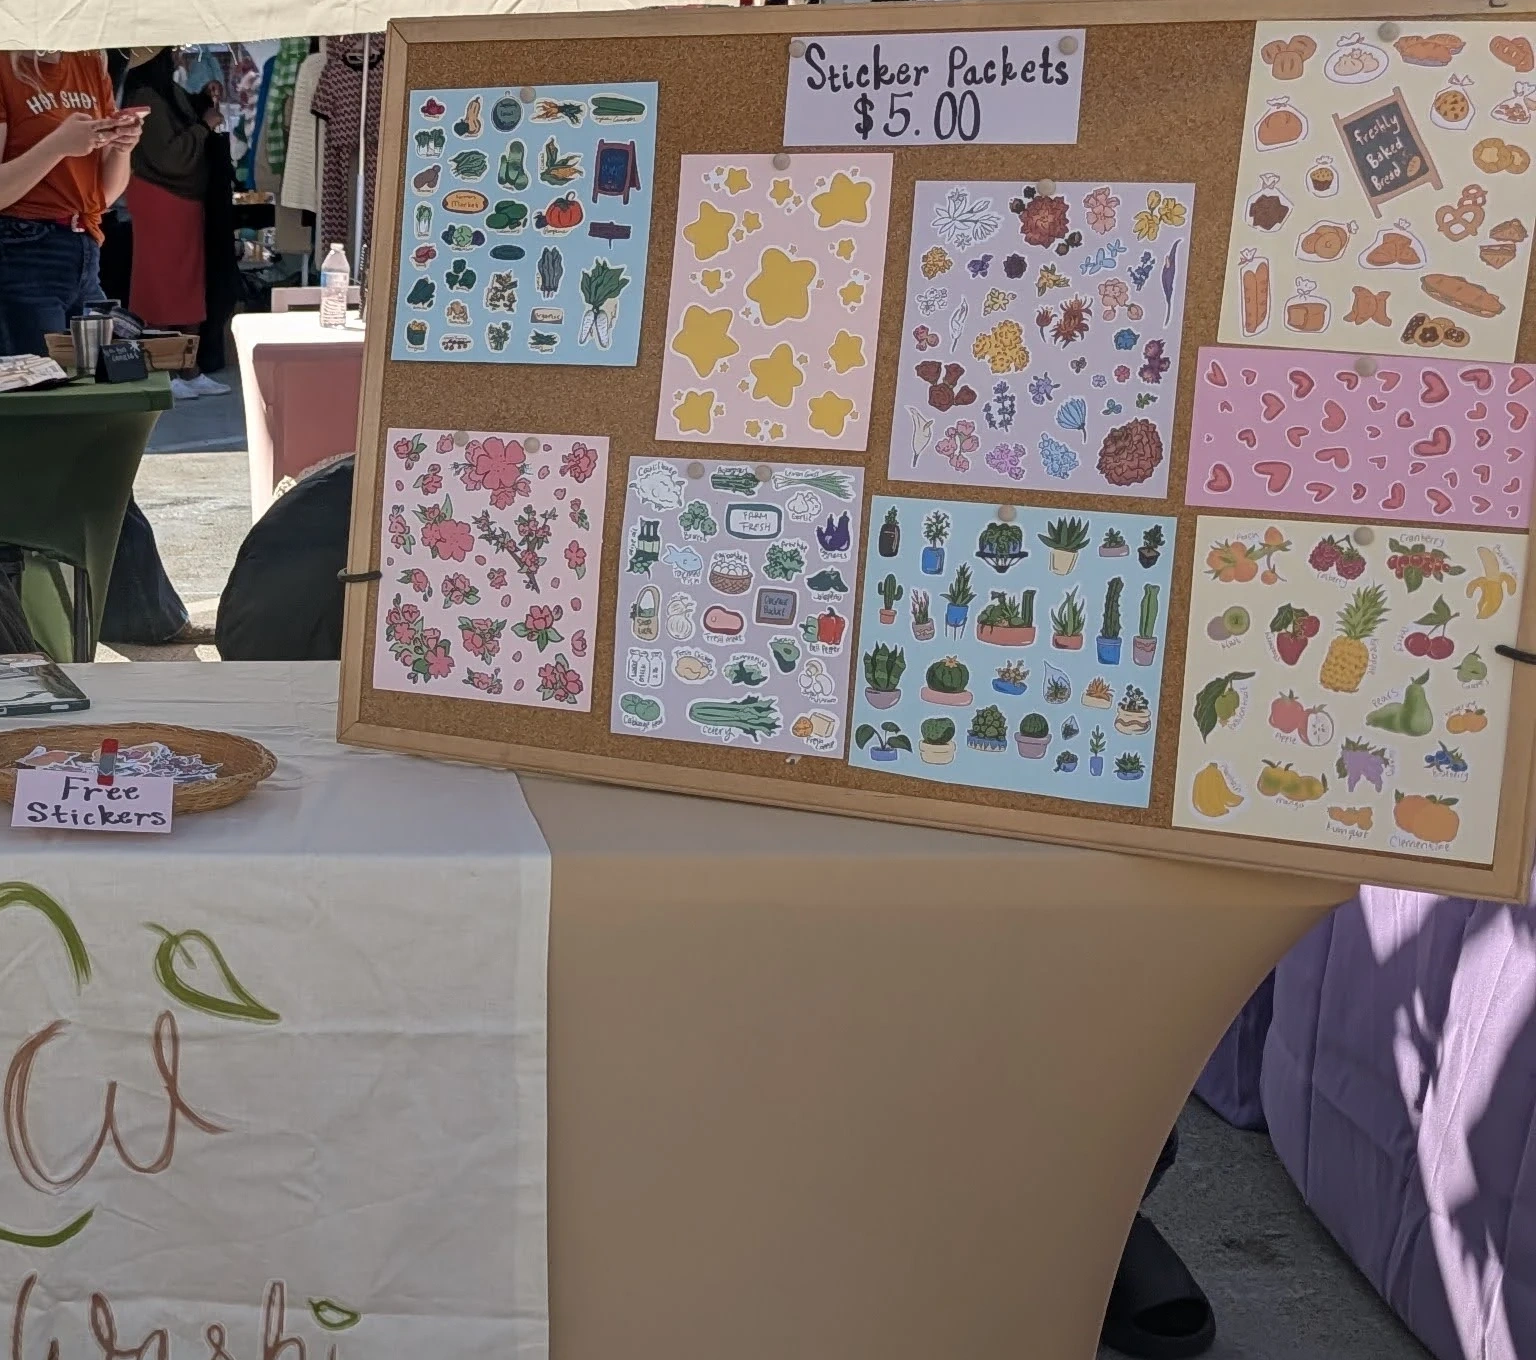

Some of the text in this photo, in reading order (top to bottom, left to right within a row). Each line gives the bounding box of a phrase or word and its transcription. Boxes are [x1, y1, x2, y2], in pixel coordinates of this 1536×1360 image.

[804, 42, 1070, 93] Sticker Packets
[25, 91, 60, 115] HOT
[853, 89, 982, 142] $5.00
[1354, 115, 1401, 146] freshly
[1366, 137, 1404, 169] Baked
[1371, 161, 1401, 192] Bread
[739, 522, 771, 532] FRESH
[743, 511, 768, 520] FARM
[61, 775, 141, 802] Free
[26, 801, 168, 827] Stickers
